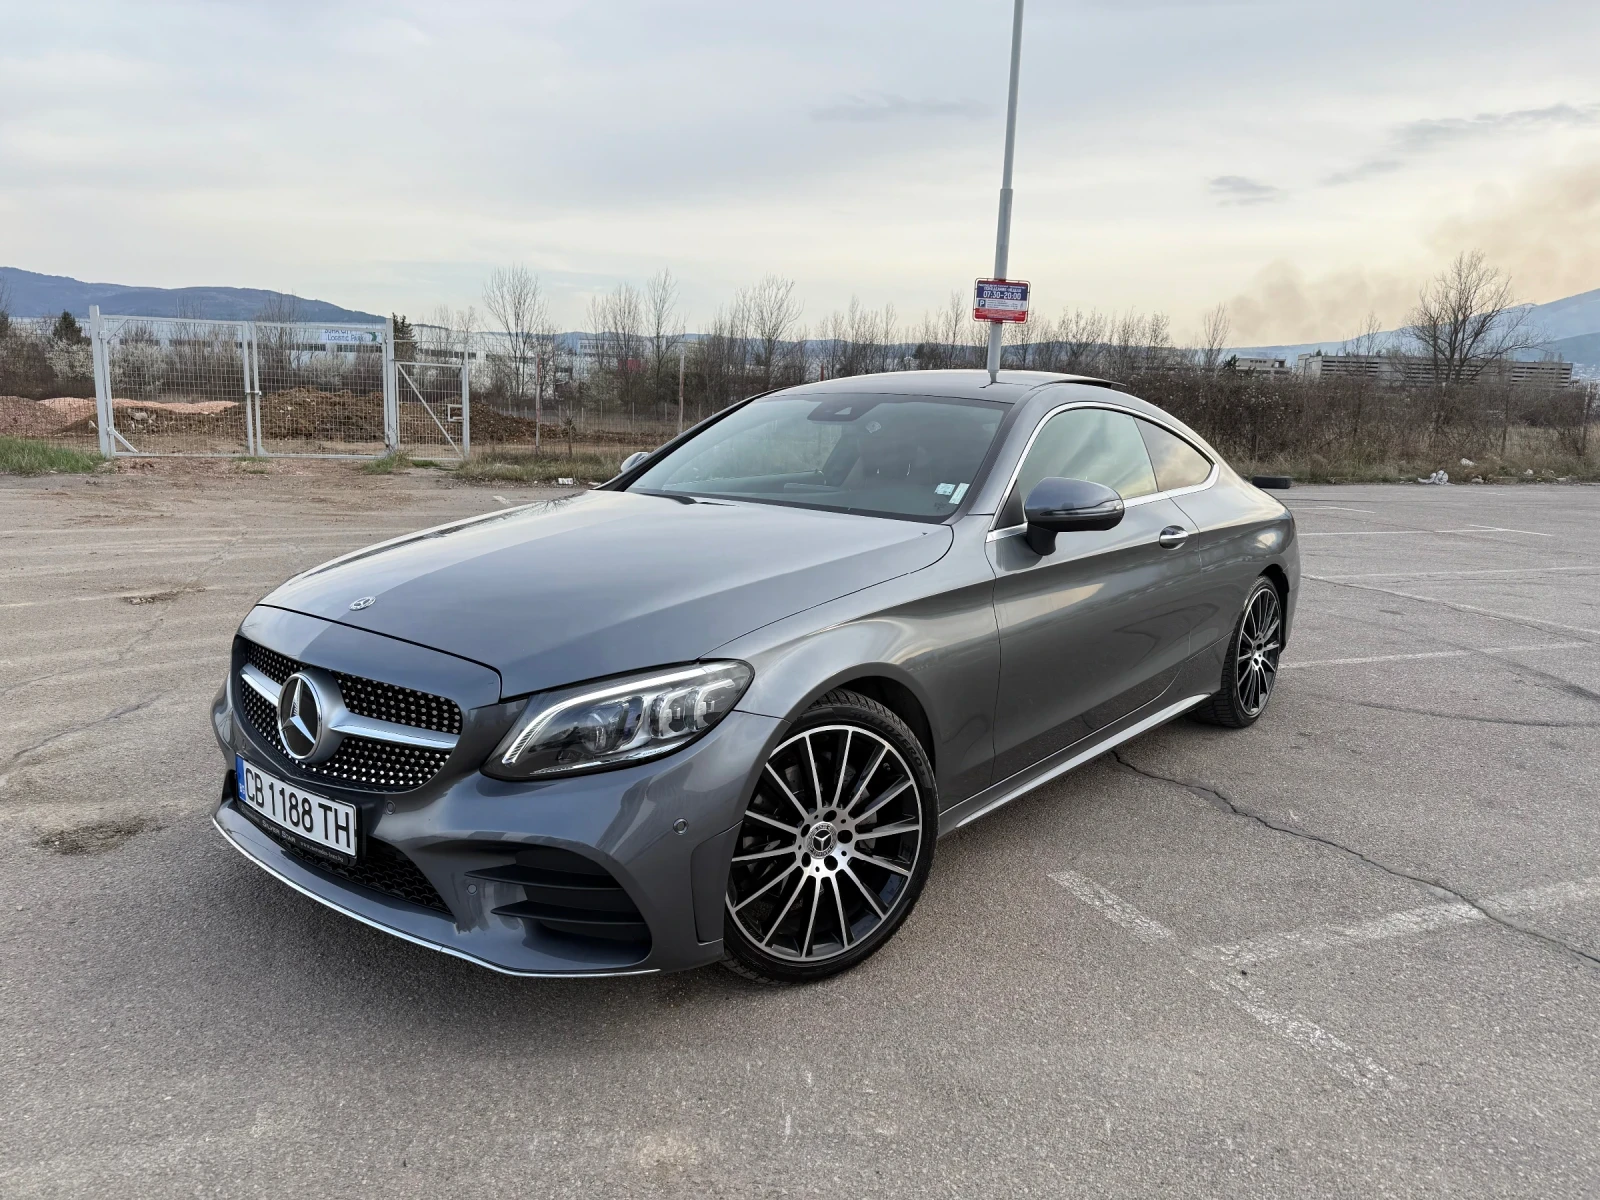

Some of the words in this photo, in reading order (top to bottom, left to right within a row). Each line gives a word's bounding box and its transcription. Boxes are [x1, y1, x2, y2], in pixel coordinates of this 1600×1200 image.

[983, 290, 1022, 300] 07:30-20:00
[245, 767, 265, 809] CB
[268, 781, 314, 834] 1188
[318, 802, 351, 849] TH
